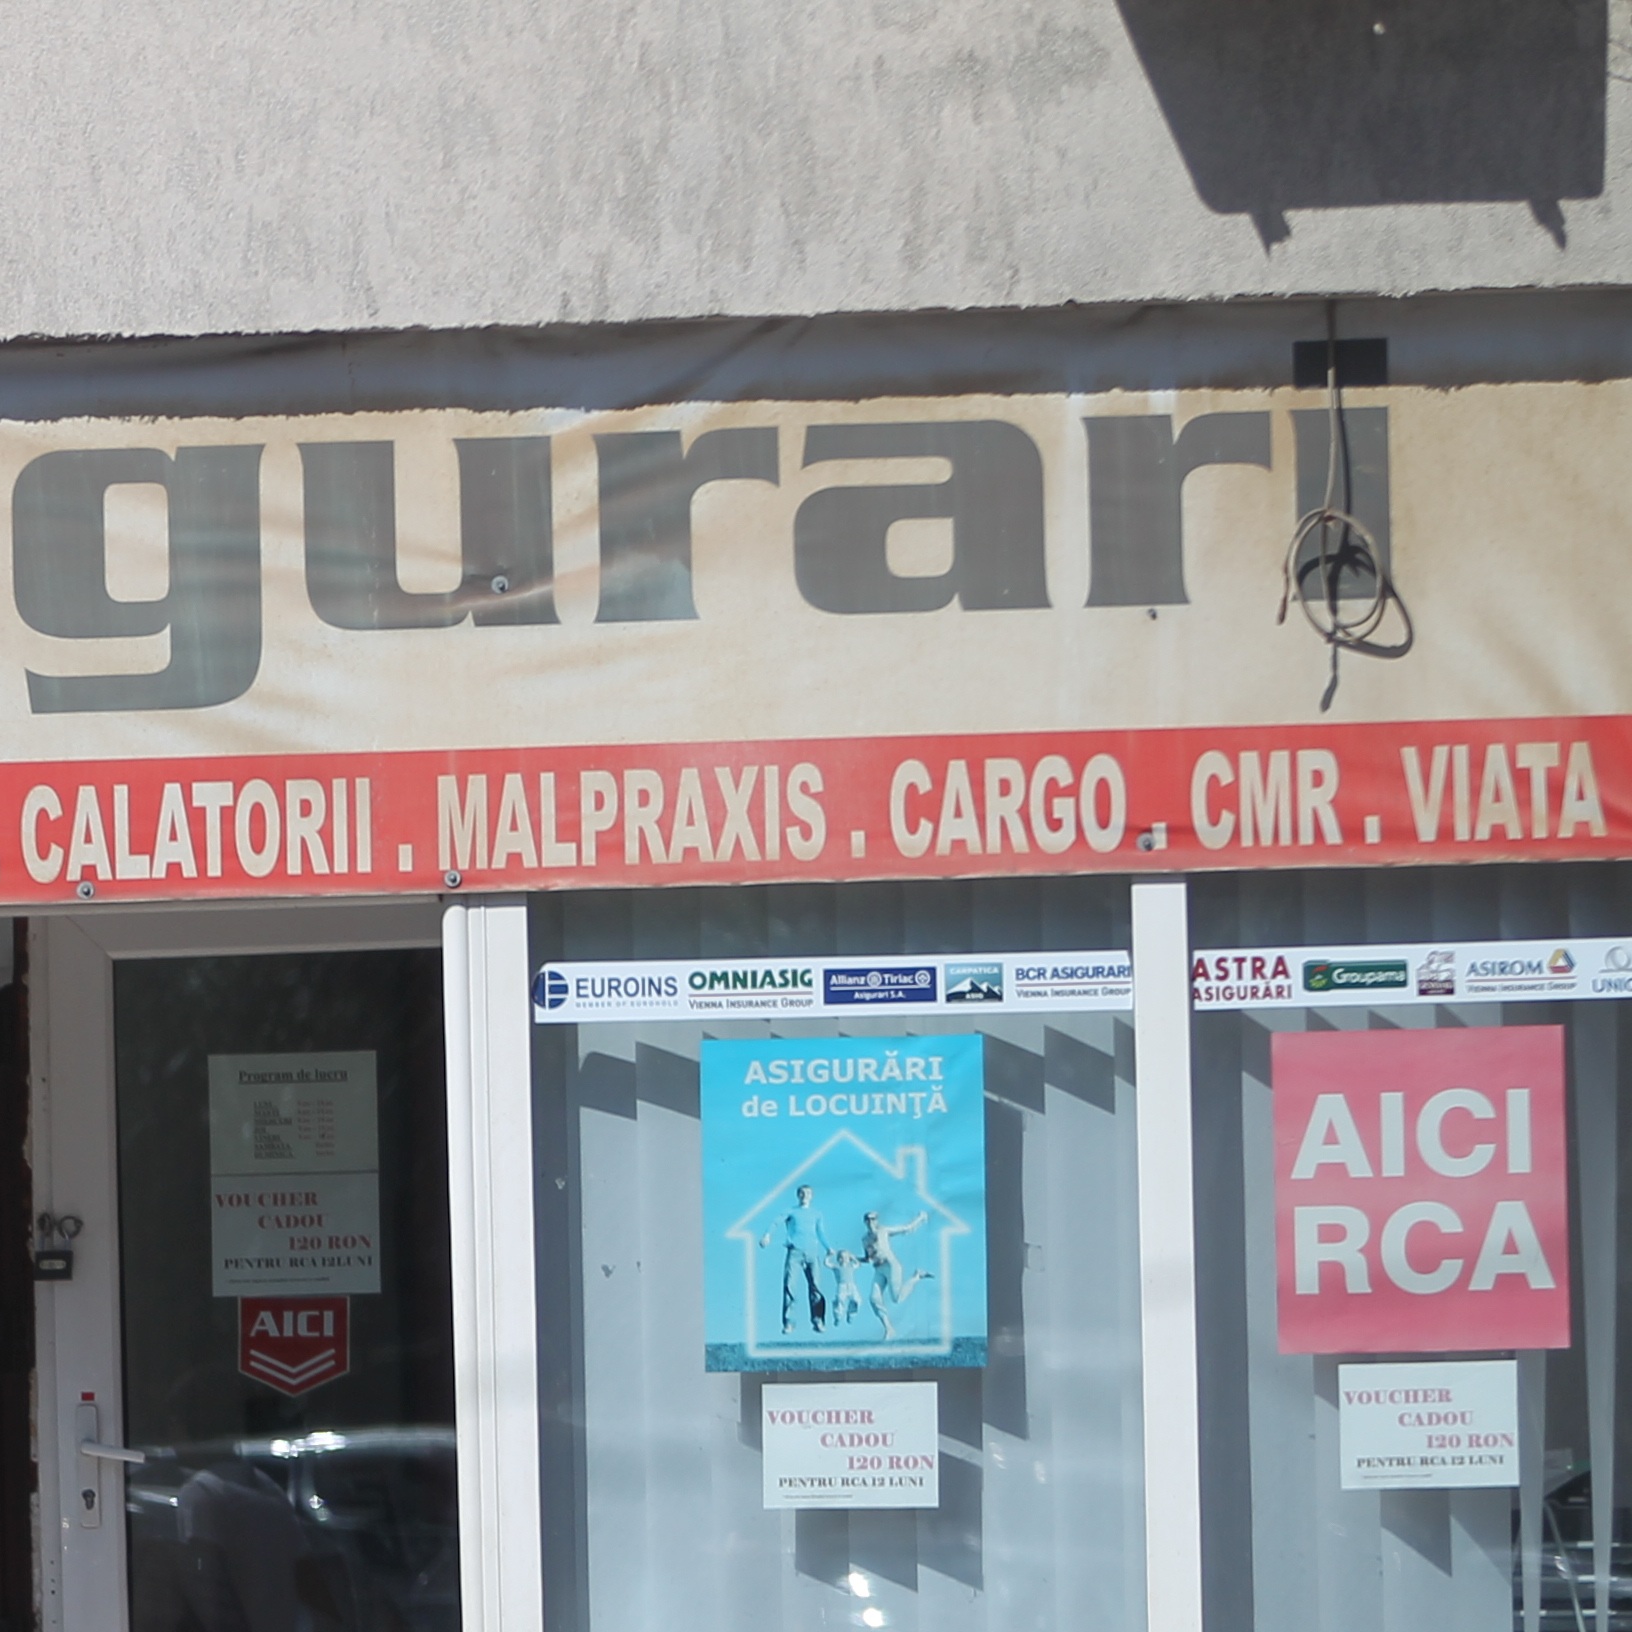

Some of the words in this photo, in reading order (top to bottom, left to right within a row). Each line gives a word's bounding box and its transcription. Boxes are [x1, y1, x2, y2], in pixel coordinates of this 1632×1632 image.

[19, 778, 372, 883] CALATORII
[438, 762, 827, 870] MALPRAXIS
[889, 753, 1127, 858] CARGO
[1190, 748, 1338, 849] CMR
[1400, 741, 1608, 842] VIATA
[1015, 966, 1047, 981] BCR
[1050, 963, 1132, 980] ASIGURARI
[1193, 955, 1292, 981] ASTRA
[1466, 960, 1544, 977] ASIROM
[688, 968, 813, 990] OMNIASIG
[830, 973, 866, 985] Allianz
[884, 973, 914, 985] Tiriac
[1332, 968, 1406, 986] Groupama
[576, 976, 678, 999] EUROINS
[744, 1050, 944, 1085] ASIGURĂRI
[239, 1070, 294, 1084] Program
[296, 1069, 311, 1082] de
[315, 1069, 348, 1082] lucru
[741, 1095, 778, 1118] de
[1290, 1088, 1532, 1180] AICI
[215, 1191, 319, 1208] VOUCHER
[258, 1213, 327, 1229] CADOU
[288, 1236, 322, 1250] 120
[328, 1234, 373, 1250] RON
[1294, 1200, 1557, 1295] RCA
[224, 1257, 285, 1270] PENTRU
[289, 1256, 318, 1268] RCA
[249, 1310, 335, 1338] AICI
[1343, 1388, 1452, 1405] VOUCHER
[767, 1410, 875, 1425] VOUCHER
[1398, 1411, 1474, 1427] CADOU
[820, 1432, 895, 1448] CADOU
[1426, 1434, 1461, 1449] 120
[1467, 1433, 1514, 1449] RON
[848, 1456, 883, 1470] 120
[888, 1455, 935, 1470] RON
[1356, 1456, 1417, 1468] PENTRU
[1420, 1456, 1448, 1467] RCA
[1468, 1455, 1504, 1465] LUNI
[778, 1477, 837, 1488] PENTRU
[841, 1477, 868, 1488] RCA
[871, 1477, 885, 1487] 12
[889, 1476, 924, 1487] LUNI
